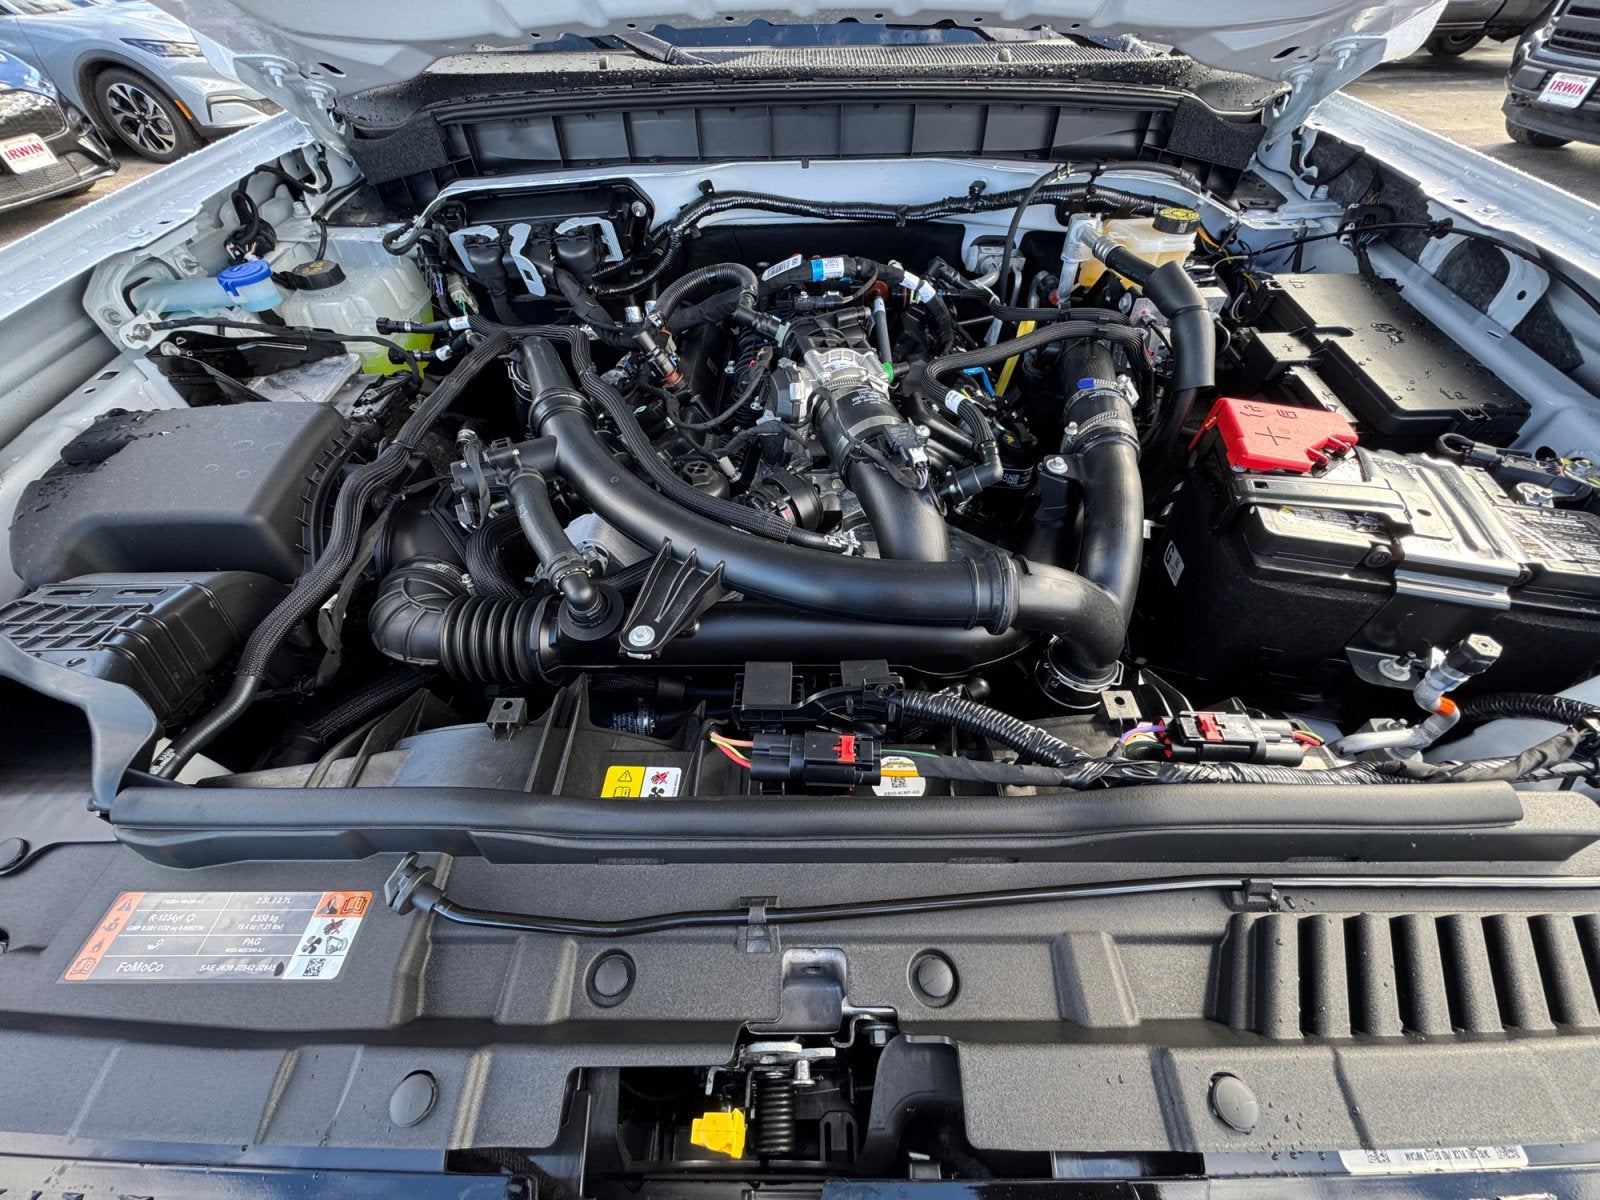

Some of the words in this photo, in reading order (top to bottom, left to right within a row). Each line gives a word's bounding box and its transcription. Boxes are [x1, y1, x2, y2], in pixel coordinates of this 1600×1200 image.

[1549, 80, 1588, 95] IRWIN
[4, 143, 44, 161] IRWIN
[149, 913, 184, 923] R-1234yf
[270, 914, 280, 923] kg
[242, 937, 262, 946] PAG
[116, 962, 164, 973] FoMoCo
